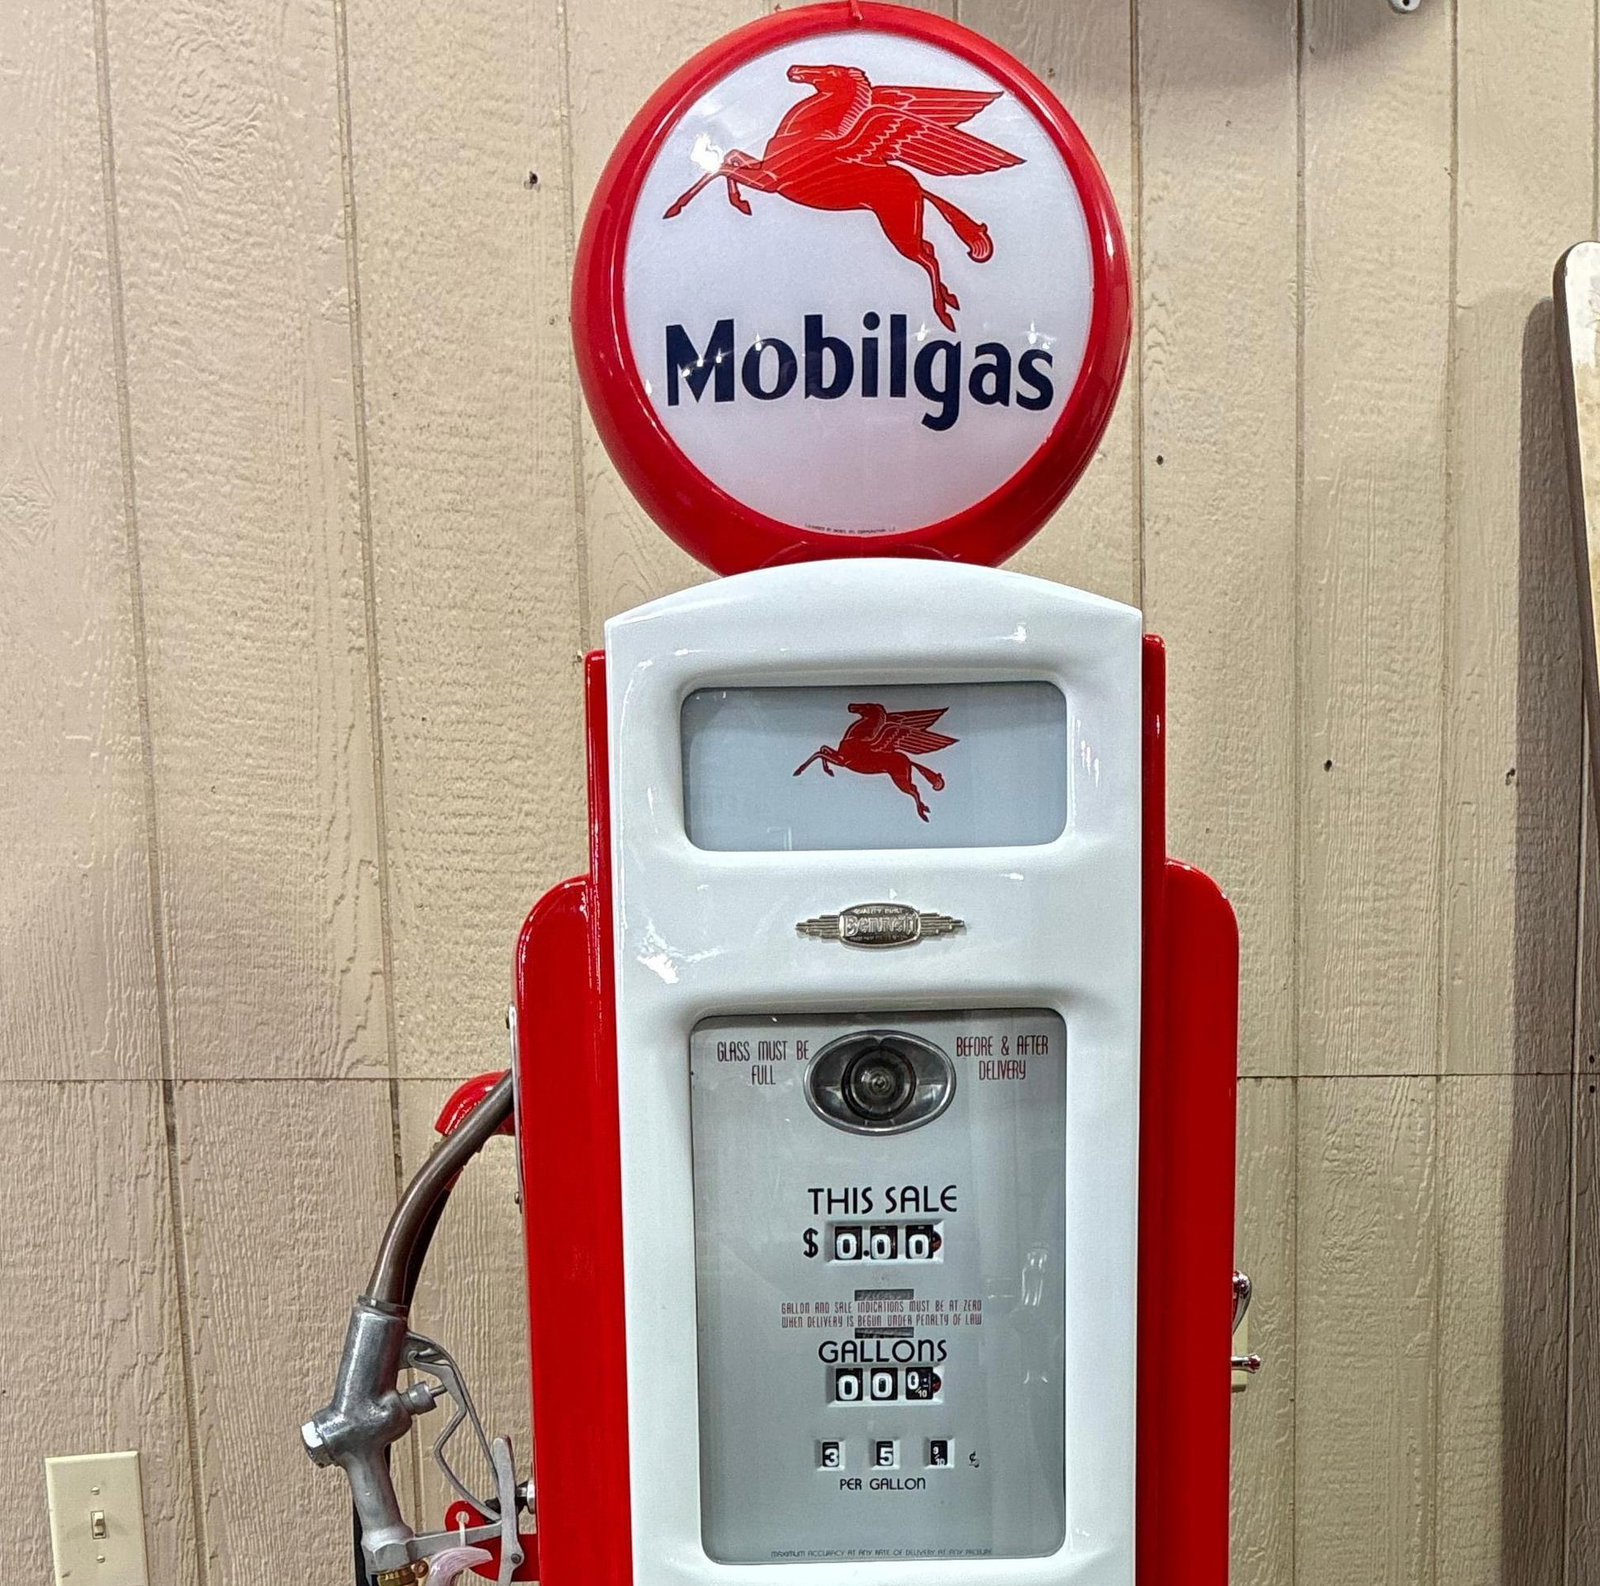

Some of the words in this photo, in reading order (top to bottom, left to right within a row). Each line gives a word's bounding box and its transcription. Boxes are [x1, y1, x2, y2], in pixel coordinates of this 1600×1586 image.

[665, 312, 1054, 431] Mobilgas
[717, 1041, 750, 1061] GLASS
[758, 1040, 788, 1061] MUST
[797, 1040, 809, 1060] BE
[956, 1036, 993, 1057] BEFORE
[1001, 1036, 1010, 1056] &
[1017, 1035, 1049, 1055] AFTER
[752, 1064, 776, 1085] FULL
[979, 1059, 1026, 1081] DELIVERY
[808, 1187, 873, 1215] THIS
[885, 1185, 957, 1213] SALE
[781, 1302, 810, 1315] GALLON
[815, 1302, 830, 1314] AND
[834, 1302, 852, 1314] SALE
[857, 1301, 904, 1314] INDICATIONS
[909, 1301, 930, 1313] MUST
[935, 1300, 944, 1312] BE
[949, 1300, 959, 1312] AT
[963, 1300, 982, 1312] ZERO
[782, 1316, 803, 1329] WHEN
[807, 1316, 843, 1328] DELIVERY
[847, 1315, 854, 1327] IS
[857, 1315, 882, 1327] BEGUN
[888, 1315, 912, 1327] UNDER
[916, 1314, 949, 1326] PENALTY
[953, 1314, 962, 1326] OF
[965, 1314, 982, 1326] LAW
[818, 1339, 947, 1363] GALLONS
[824, 1448, 839, 1467] 3
[879, 1447, 893, 1466] 5
[840, 1478, 862, 1491] PER
[870, 1477, 926, 1491] GALLON
